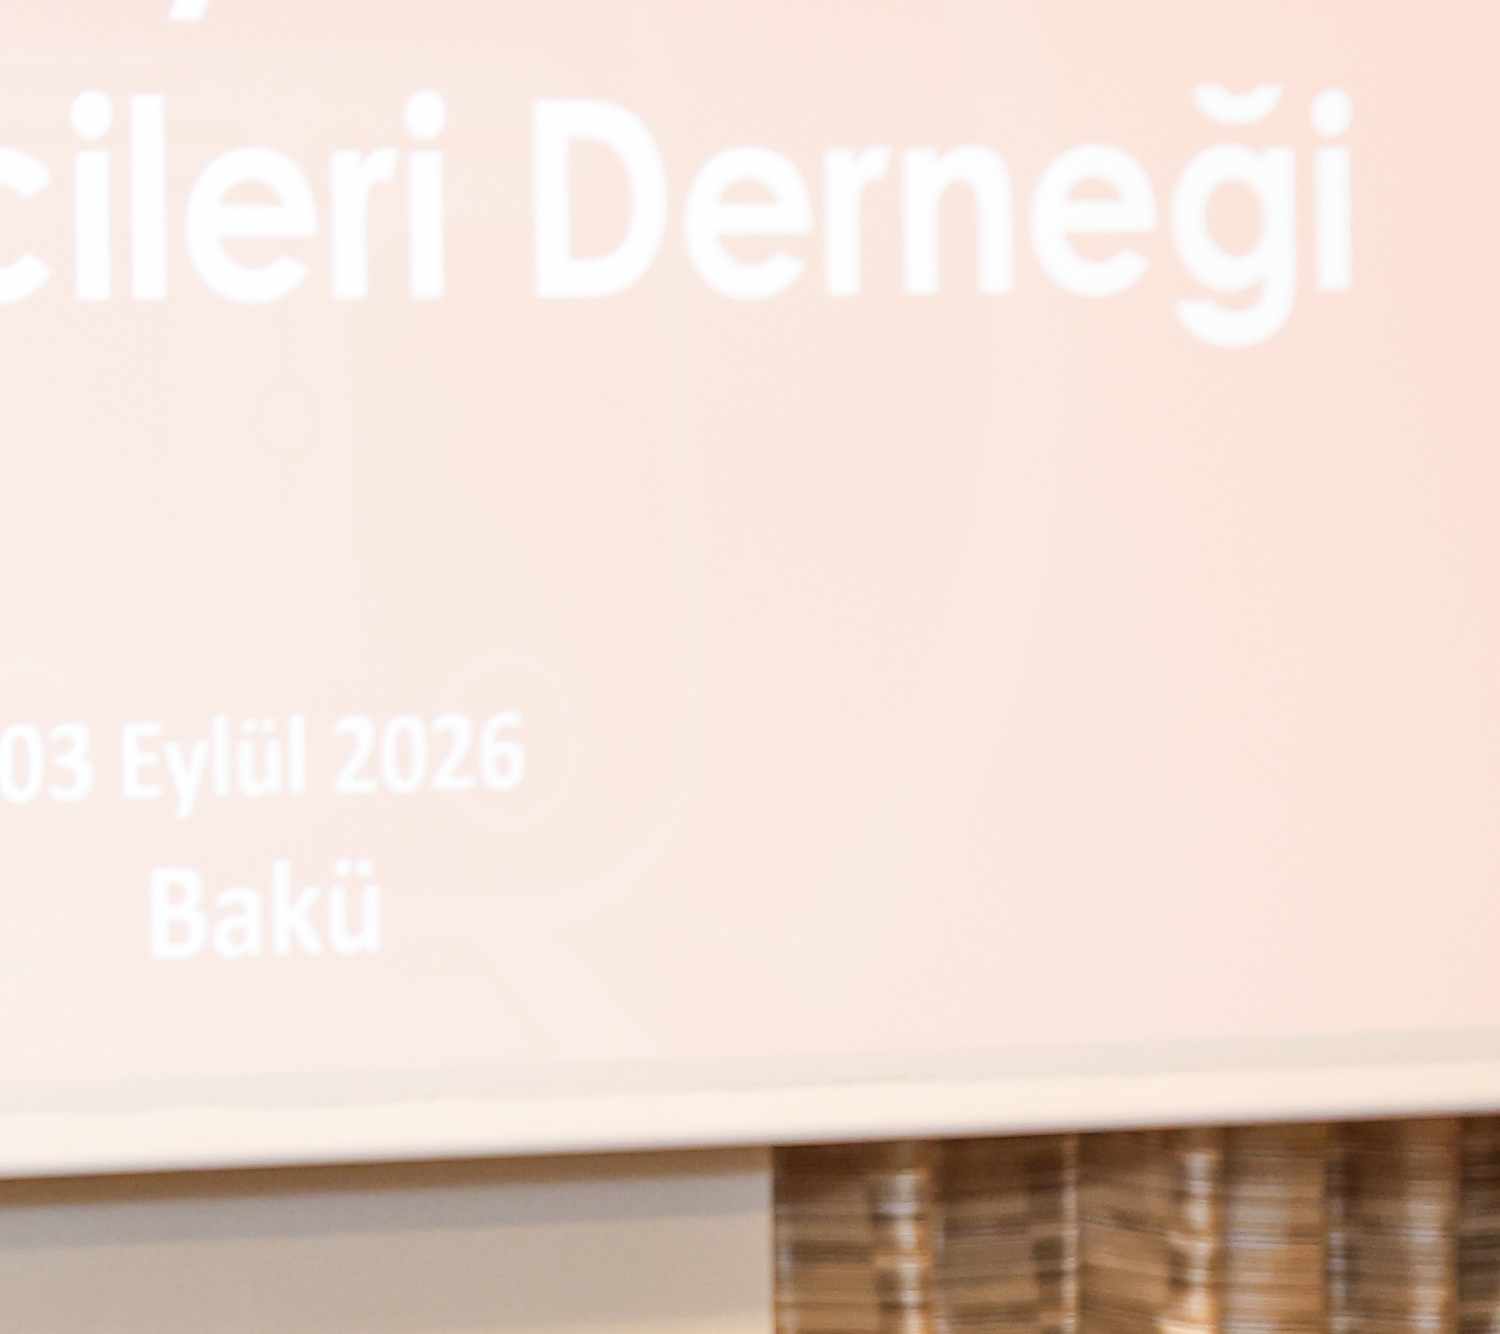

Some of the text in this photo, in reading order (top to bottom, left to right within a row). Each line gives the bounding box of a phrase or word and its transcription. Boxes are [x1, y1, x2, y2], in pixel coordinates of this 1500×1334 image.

[533, 84, 1353, 347] Derneği
[121, 713, 306, 819] Eylül
[332, 711, 525, 794] 2026
[150, 859, 382, 959] Bakü
